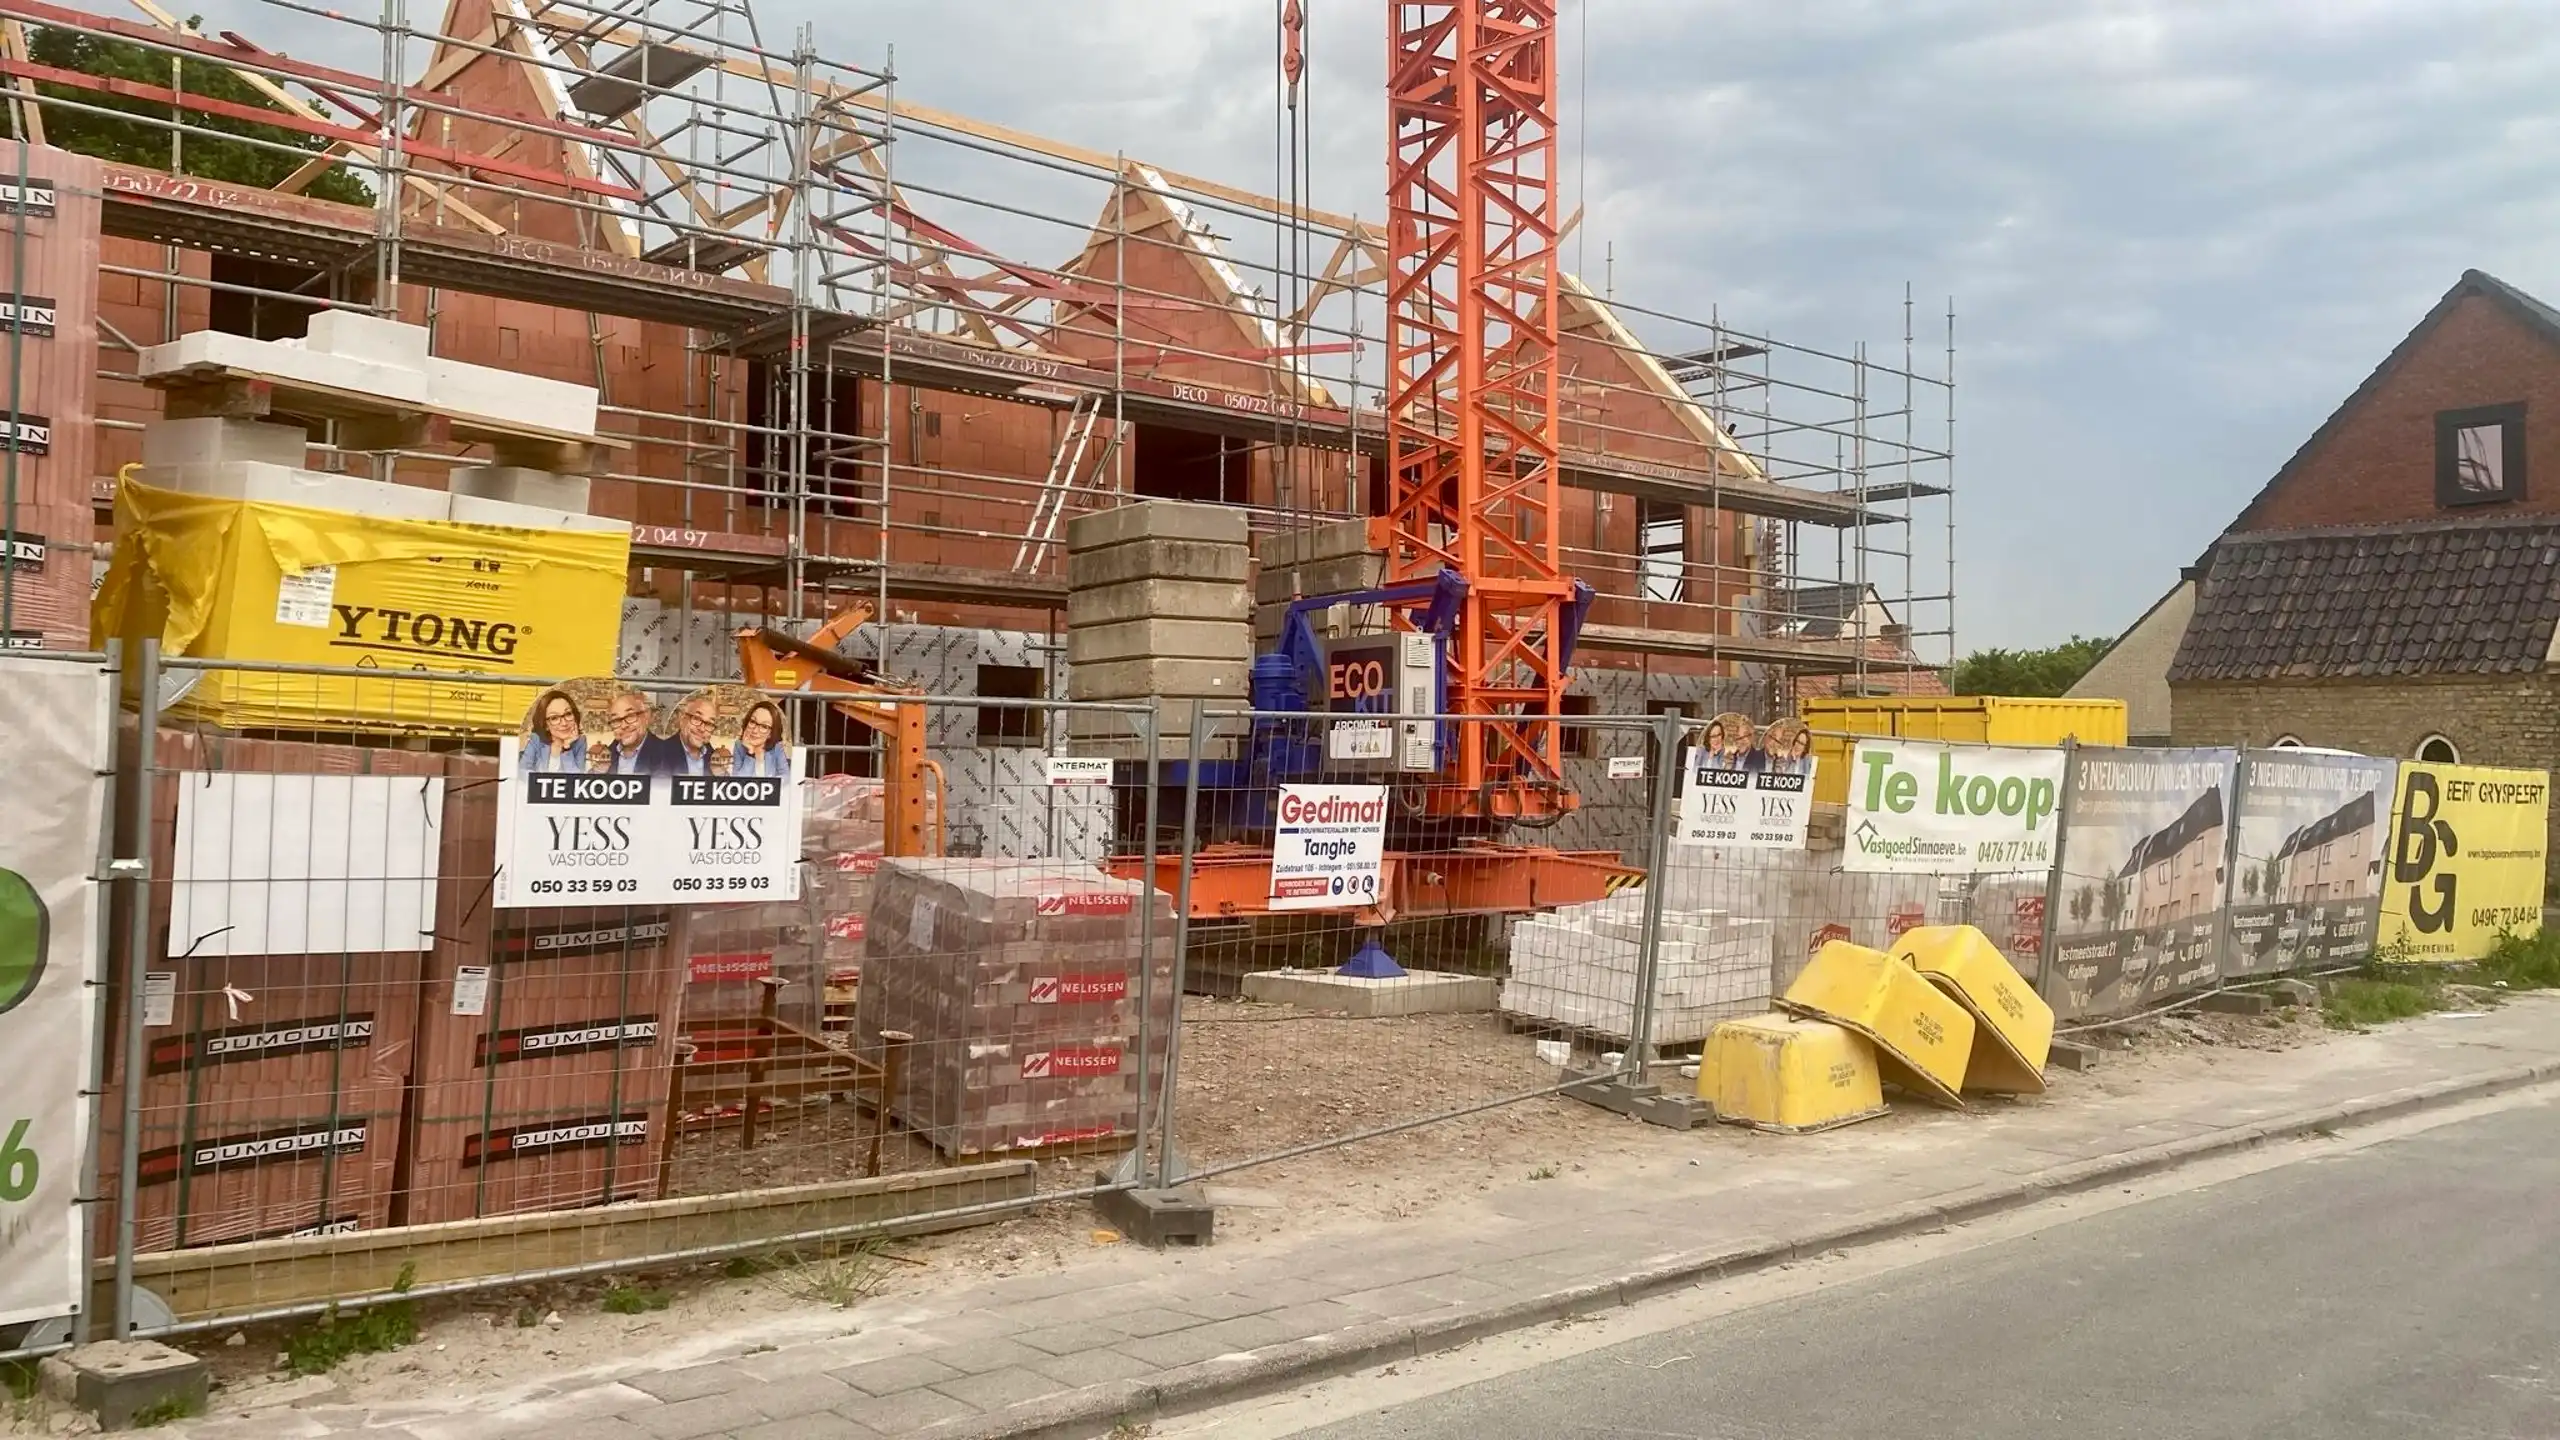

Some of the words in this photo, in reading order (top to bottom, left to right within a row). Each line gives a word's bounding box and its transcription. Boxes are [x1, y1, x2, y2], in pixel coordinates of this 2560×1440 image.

[1172, 385, 1208, 402] DECO
[1224, 394, 1268, 413] 050/22
[654, 528, 677, 544] 04
[684, 530, 708, 547] 97
[1330, 660, 1384, 698] ECO
[1053, 762, 1109, 770] INTERMAT
[2079, 761, 2088, 790] 3
[2249, 762, 2257, 787] 3
[1700, 771, 1713, 783] TE
[1715, 773, 1745, 785] KOOP
[1760, 775, 1772, 787] TE
[1773, 776, 1802, 789] KOOP
[537, 779, 566, 798] TE
[574, 780, 643, 799] KOOP
[680, 781, 705, 800] TE
[712, 782, 774, 801] KOOP
[1862, 751, 1918, 814] Te
[1935, 752, 2054, 831] koop
[2447, 780, 2475, 802] BERT
[2479, 782, 2545, 804] GRYSPEERT
[1282, 795, 1384, 824] Gedimat
[1702, 793, 1738, 814] YESS
[1761, 796, 1795, 817] YESS
[547, 816, 631, 851] YESS
[687, 817, 763, 850] YESS
[1691, 830, 1705, 838] 050
[1706, 830, 1715, 838] 33
[1717, 831, 1726, 839] 59
[1727, 831, 1737, 839] 03
[1750, 832, 1764, 840] 050
[1765, 833, 1774, 841] 33
[1784, 834, 1793, 842] 03
[549, 852, 629, 866] VASTGOED
[689, 852, 762, 865] VASTGOED
[1305, 839, 1356, 860] Tanghe
[1978, 841, 2003, 862] 0476
[2005, 842, 2019, 862] 77
[2020, 842, 2034, 861] 24
[2035, 841, 2047, 861] 46
[531, 880, 563, 893] 050
[567, 880, 587, 893] 33
[592, 879, 613, 892] 59
[617, 879, 637, 892] 03
[673, 878, 701, 890] 050
[705, 878, 723, 890] 33
[729, 877, 747, 889] 59
[751, 877, 769, 889] 03
[1069, 895, 1128, 905] NELISSEN
[2472, 908, 2497, 927] 0496
[2500, 908, 2511, 926] 72
[2513, 907, 2526, 924] 84
[1061, 982, 1124, 993] NELISSEN
[210, 1022, 372, 1051] DUMOULIN
[524, 1023, 657, 1048] DUMOULIN
[1055, 1056, 1116, 1067] NELISSEN
[198, 1129, 365, 1162] DUMOULIN
[0, 1119, 39, 1201] 6
